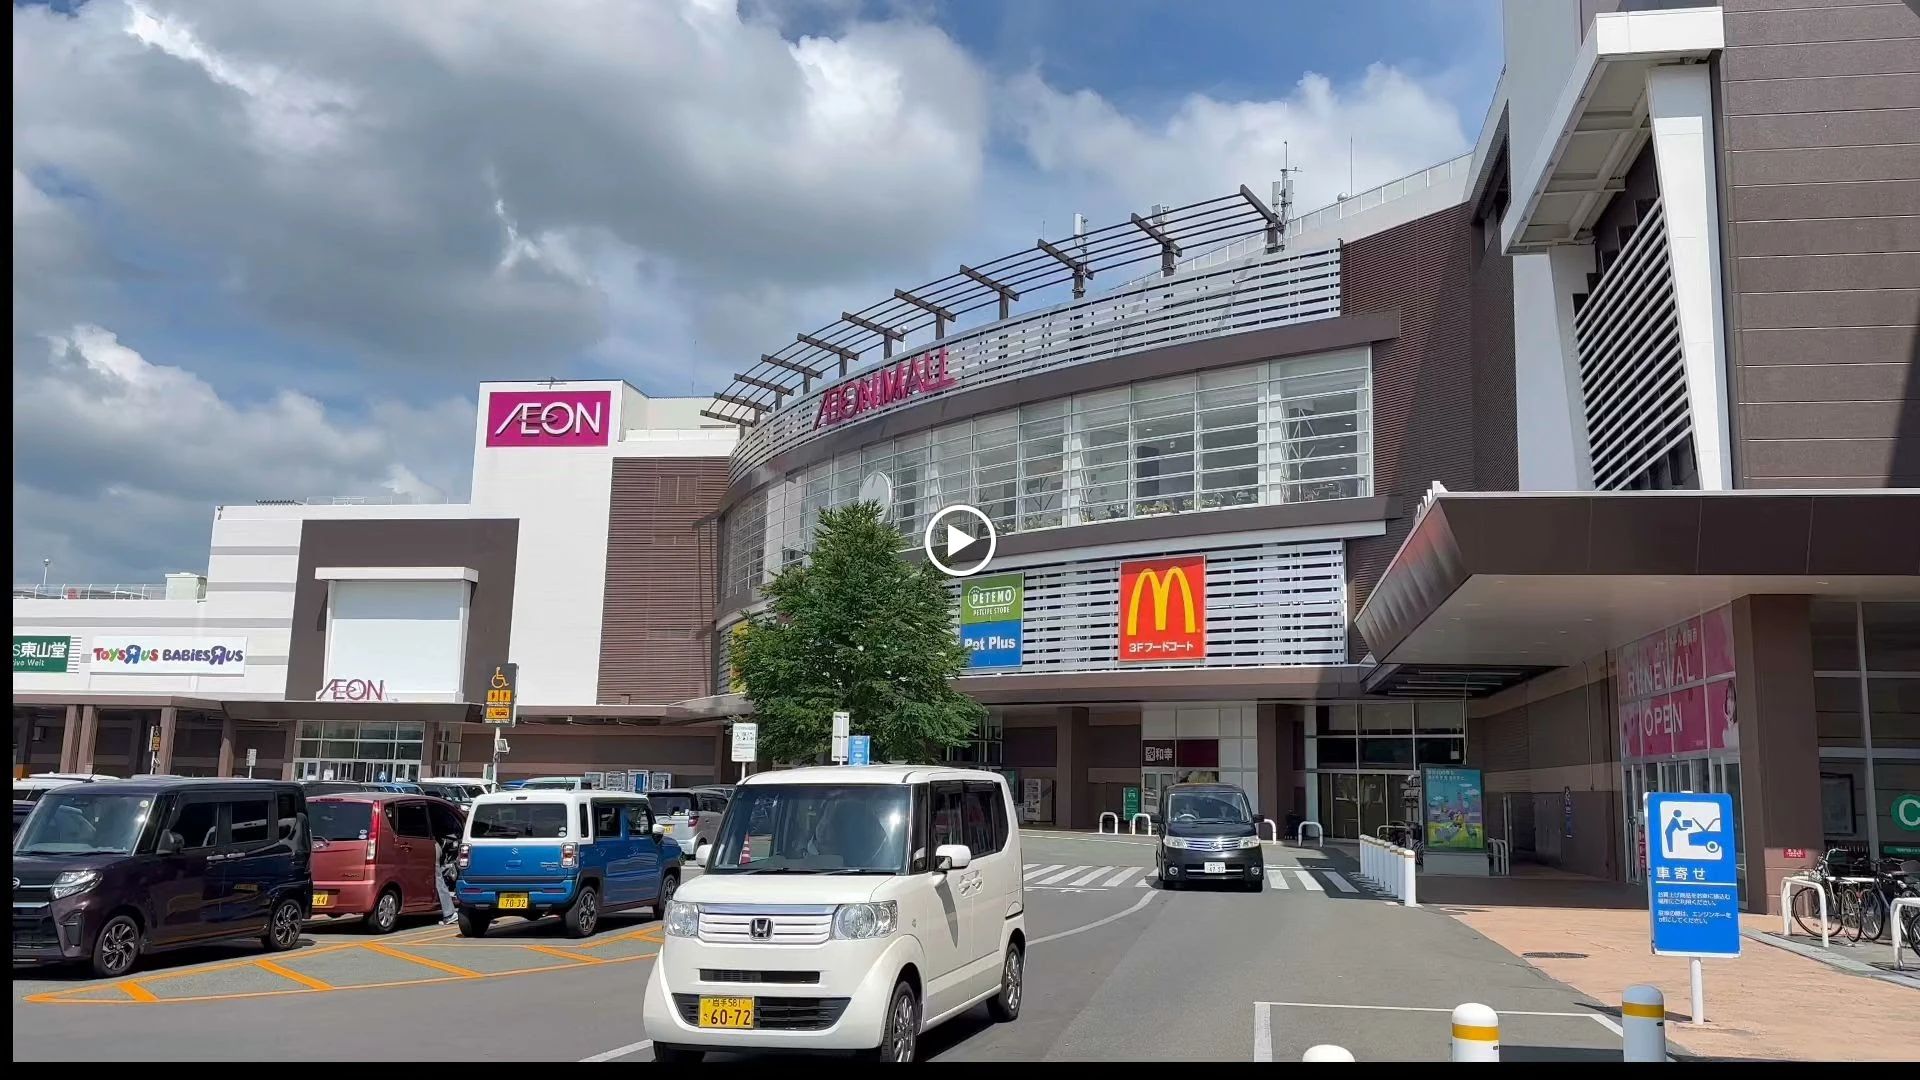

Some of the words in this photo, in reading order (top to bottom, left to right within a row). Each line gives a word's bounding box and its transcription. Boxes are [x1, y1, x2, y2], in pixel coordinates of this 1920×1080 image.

[972, 589, 1013, 605] PETEMO
[973, 608, 993, 617] PETLIFE
[994, 606, 1010, 614] STORE
[964, 637, 985, 651] Pet
[988, 635, 1016, 650] Plus
[1129, 641, 1194, 653] 3Fフードコート
[1644, 702, 1683, 737] OPEN
[1656, 866, 1706, 880] 車寄せ
[711, 1009, 751, 1025] 60-72
